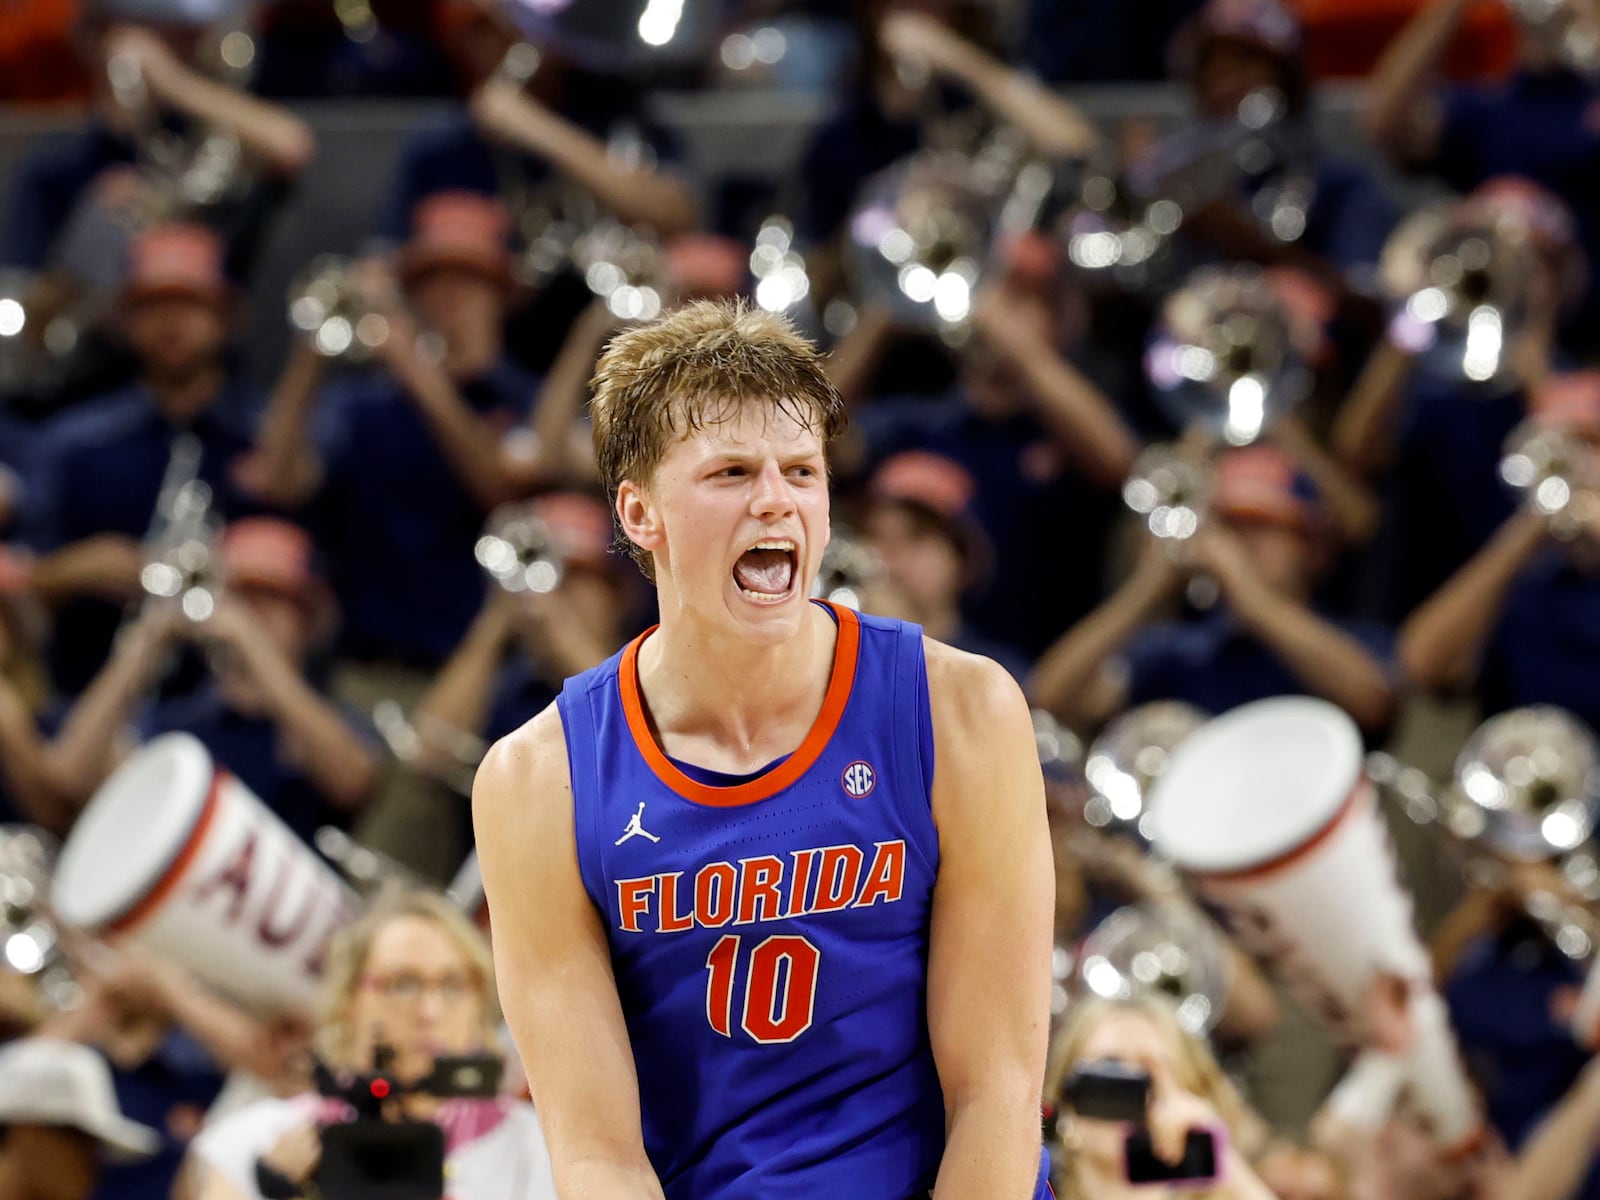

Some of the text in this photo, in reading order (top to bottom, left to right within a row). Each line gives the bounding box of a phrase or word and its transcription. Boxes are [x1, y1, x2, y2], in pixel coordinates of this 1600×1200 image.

[845, 764, 873, 795] SEC
[614, 839, 906, 934] FLORIDA
[706, 934, 821, 1045] 10
